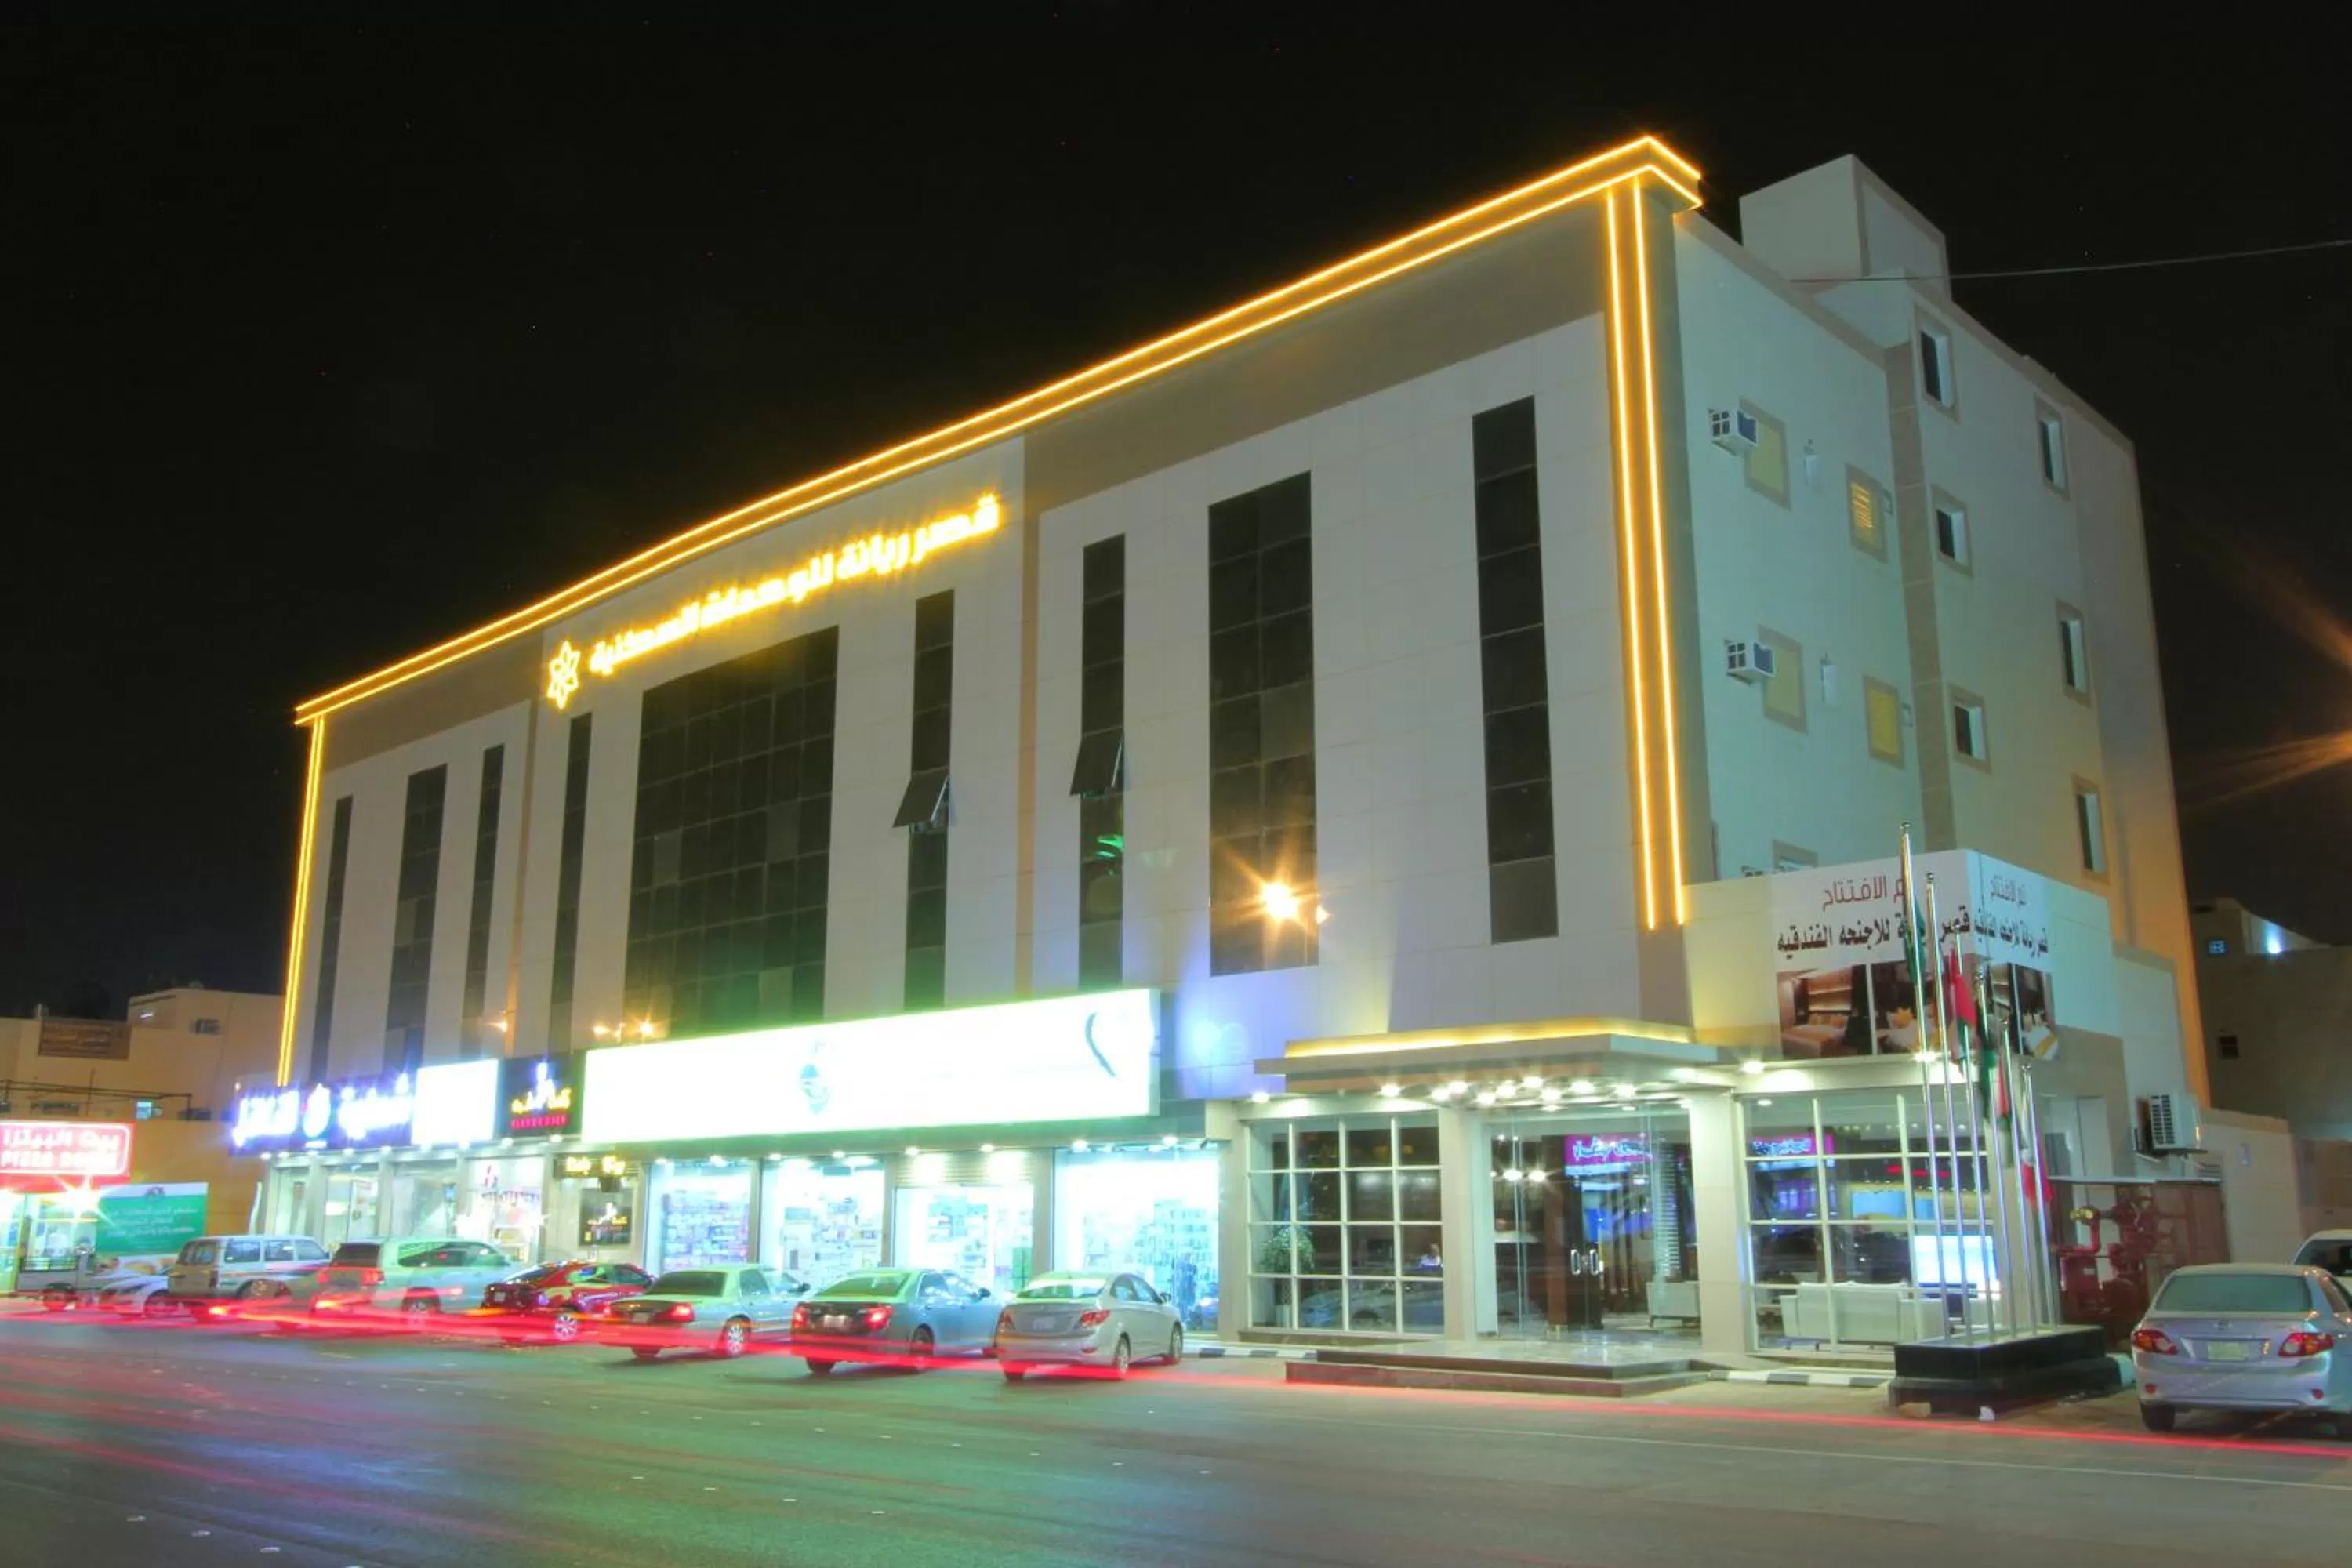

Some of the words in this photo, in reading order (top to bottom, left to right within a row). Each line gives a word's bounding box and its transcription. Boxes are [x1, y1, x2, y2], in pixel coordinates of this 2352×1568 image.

[910, 494, 1000, 564] قصر
[1822, 875, 1887, 911] الافتتاح
[1940, 904, 1971, 942] قصر
